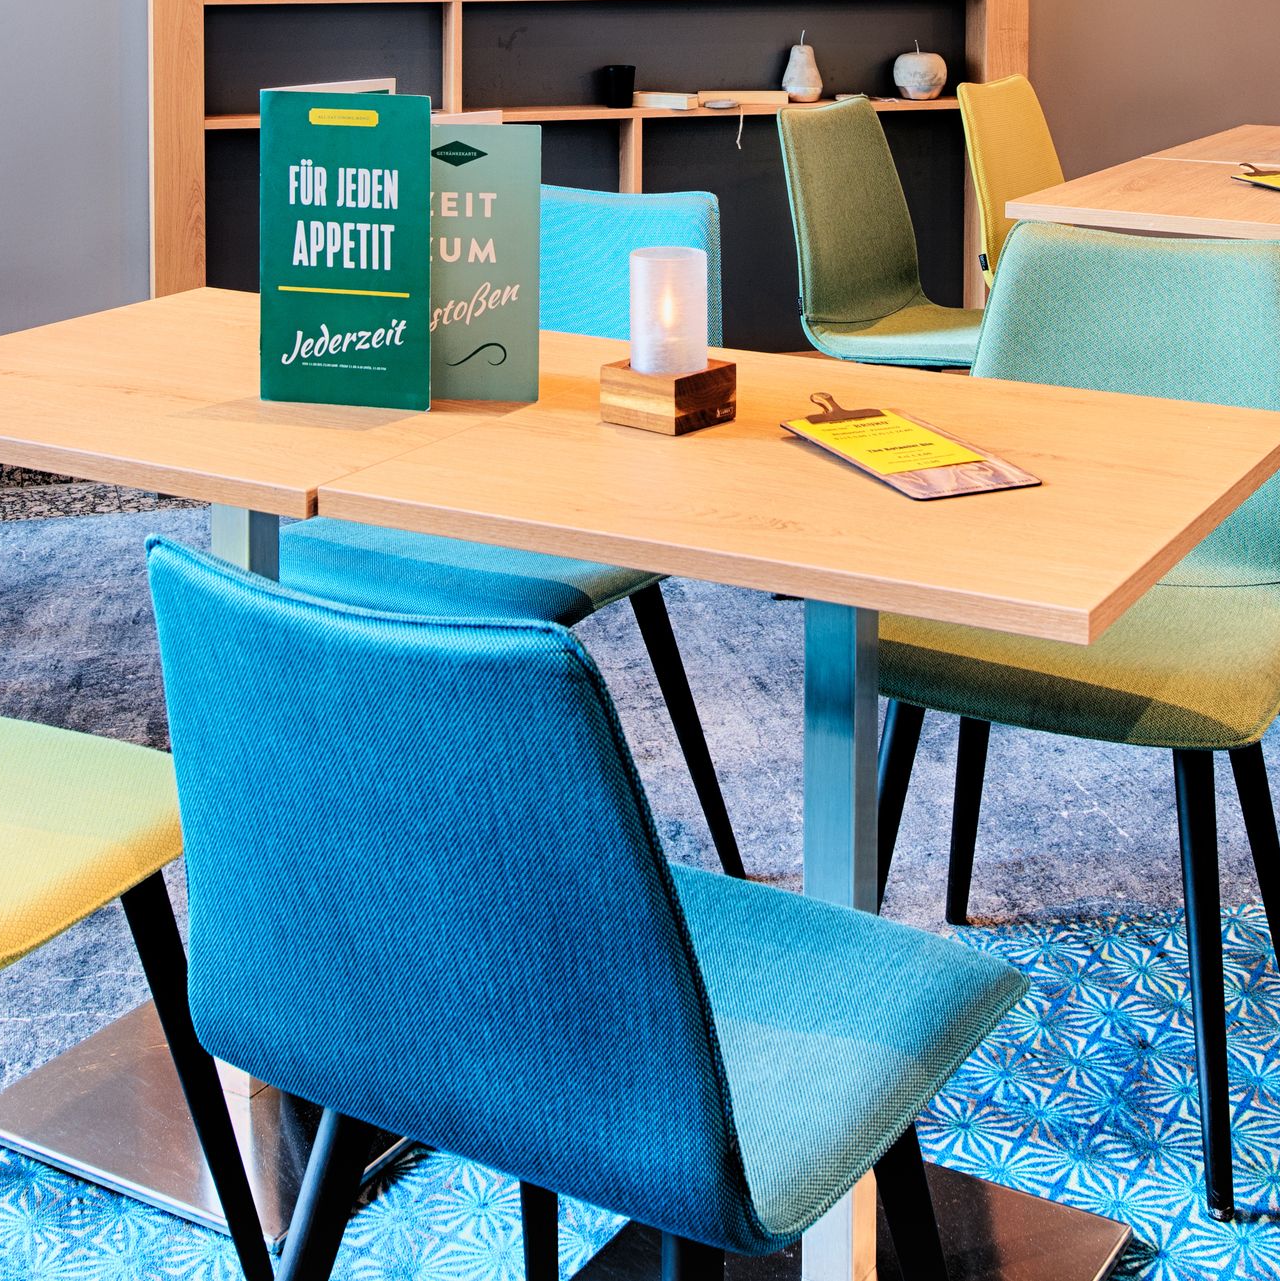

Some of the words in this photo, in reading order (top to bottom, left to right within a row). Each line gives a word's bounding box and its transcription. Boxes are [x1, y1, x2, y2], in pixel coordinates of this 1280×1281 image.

[289, 158, 327, 207] FÜR
[336, 167, 399, 210] JEDEN
[292, 220, 395, 271] APPETIT
[431, 237, 497, 263] UM
[429, 281, 520, 332] stoßen
[281, 319, 407, 366] Jederzeit
